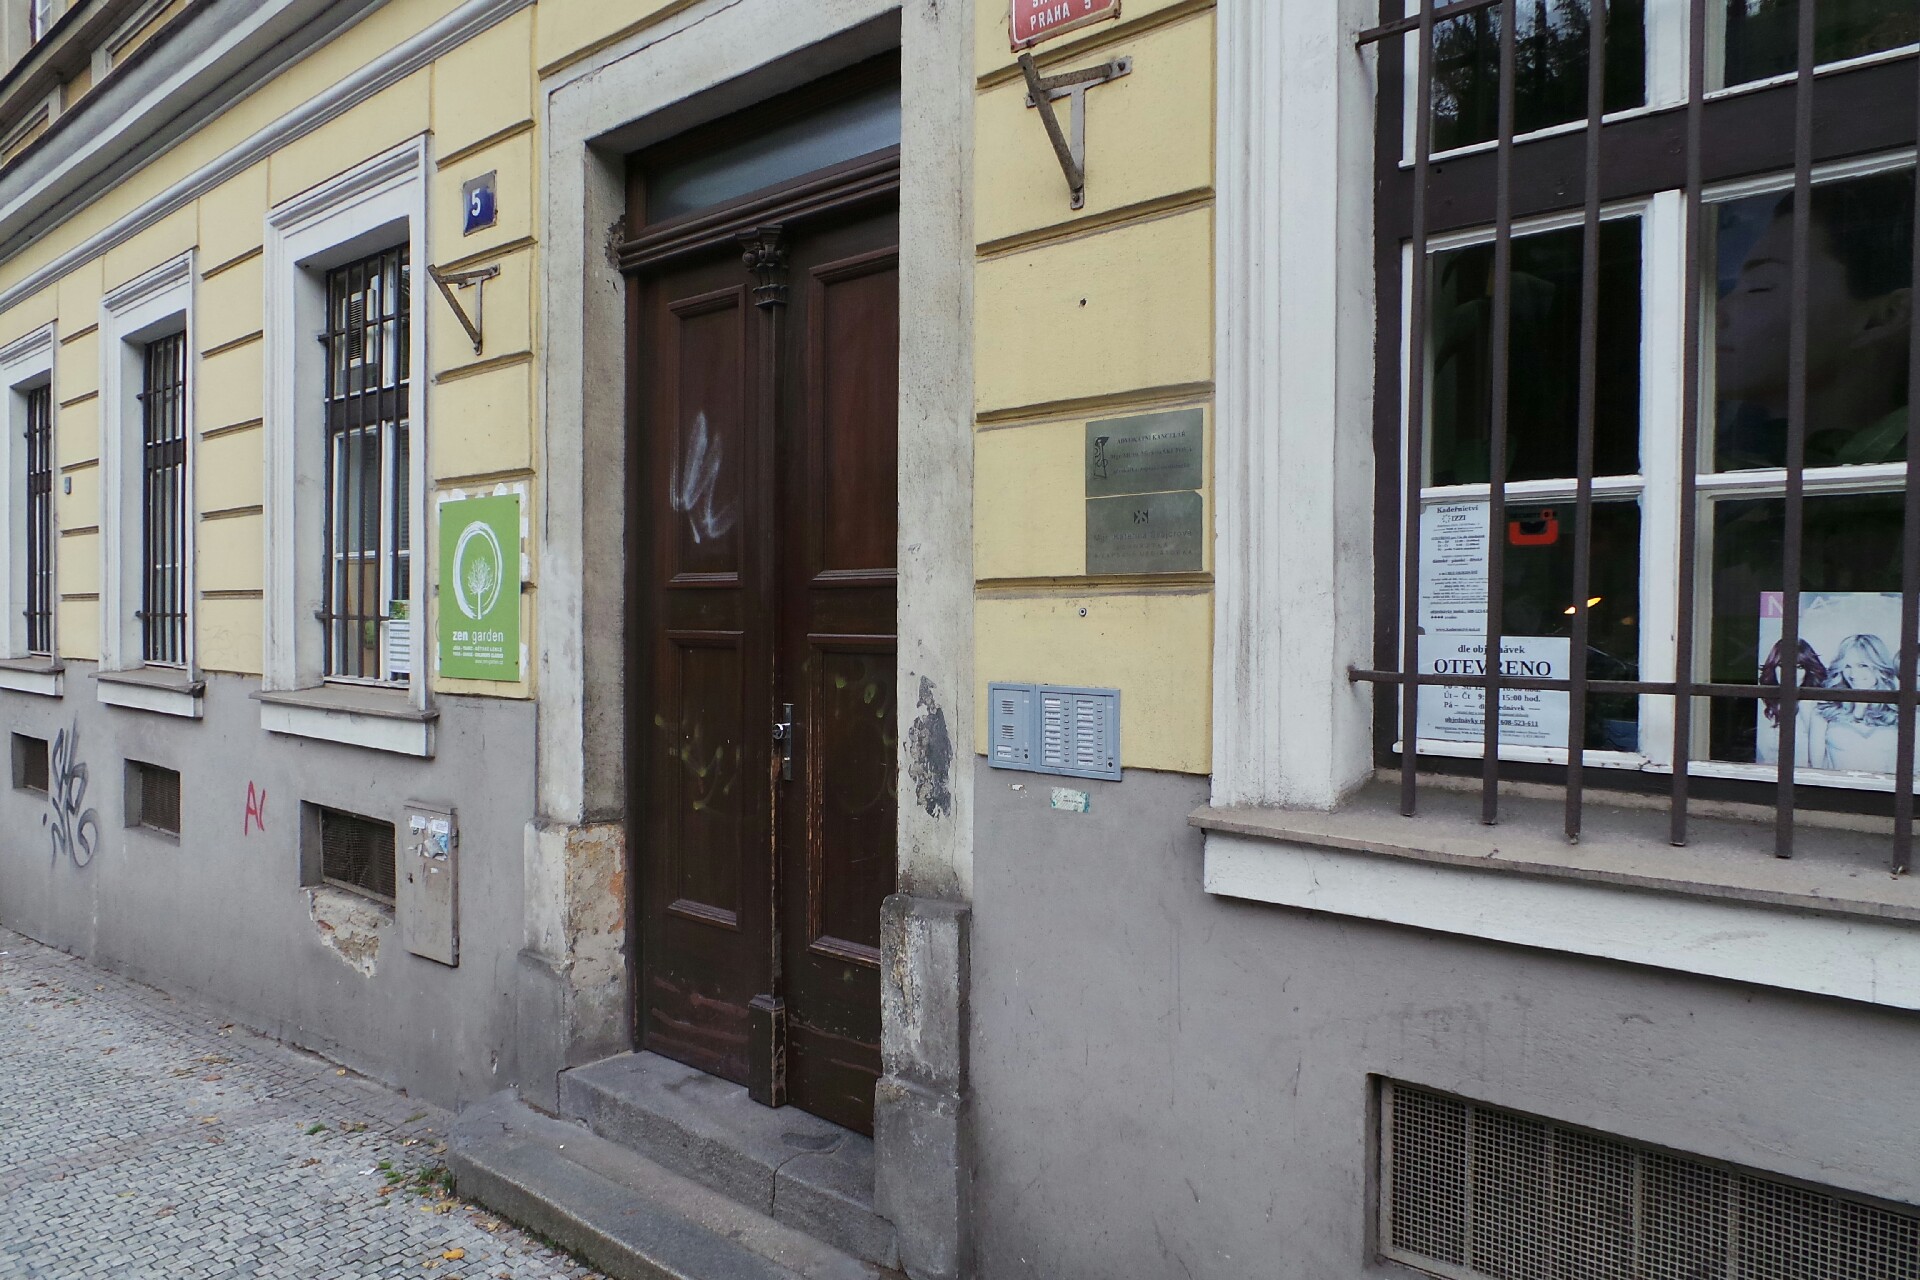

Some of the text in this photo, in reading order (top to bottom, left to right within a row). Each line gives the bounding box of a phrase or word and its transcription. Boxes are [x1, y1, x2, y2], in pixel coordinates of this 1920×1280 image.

[1030, 2, 1070, 30] PRAHA
[471, 187, 481, 217] 5
[1436, 504, 1479, 514] Kadeřnictví
[453, 628, 504, 644] zen garden
[1457, 644, 1471, 654] dle
[1502, 694, 1523, 702] 15:00
[1524, 694, 1541, 703] hod.
